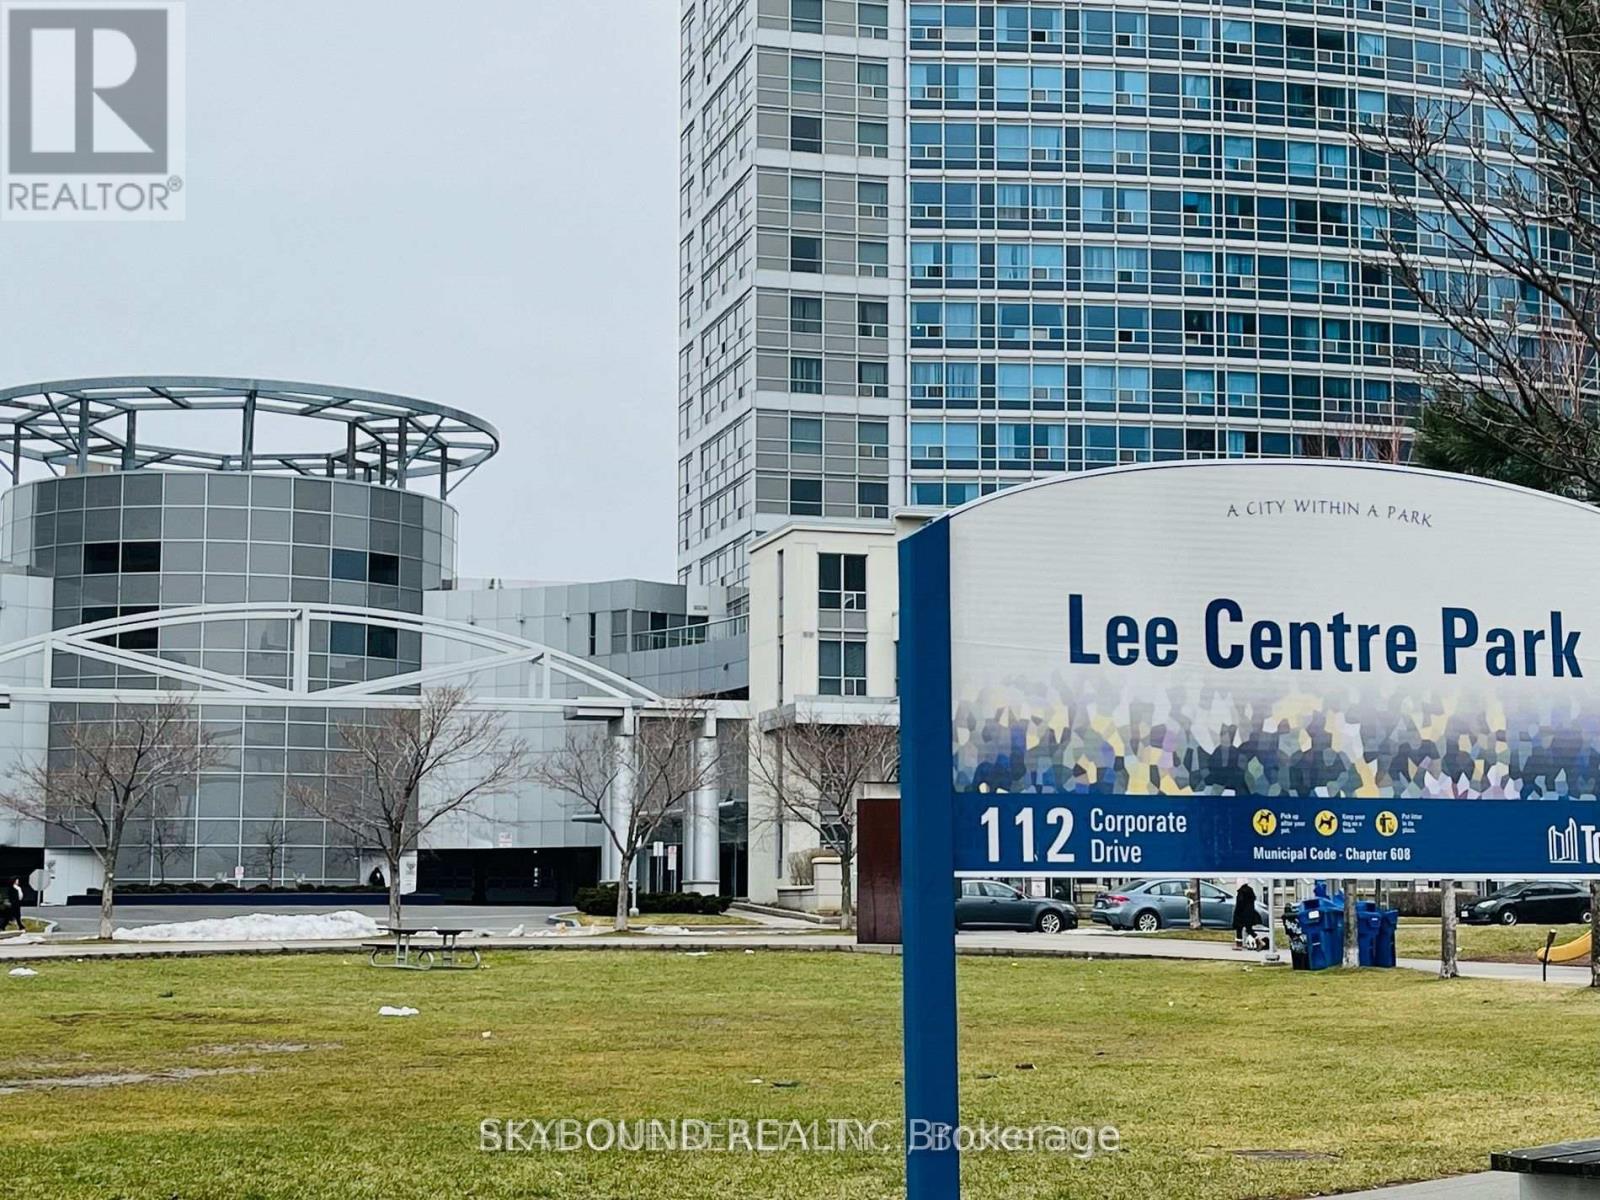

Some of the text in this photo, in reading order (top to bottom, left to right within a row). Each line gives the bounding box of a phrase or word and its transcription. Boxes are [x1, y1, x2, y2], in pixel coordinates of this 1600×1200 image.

[1227, 499, 1432, 528] A CITY WITHIN A PARK
[1068, 593, 1583, 678] Lee Centre Park
[980, 807, 1075, 863] 112
[1090, 807, 1187, 838] Corporate
[1091, 839, 1142, 864] Drive
[1253, 846, 1307, 862] Municipal
[1310, 847, 1337, 860] Code
[1345, 847, 1388, 863] Chapter
[1390, 847, 1412, 861] 608
